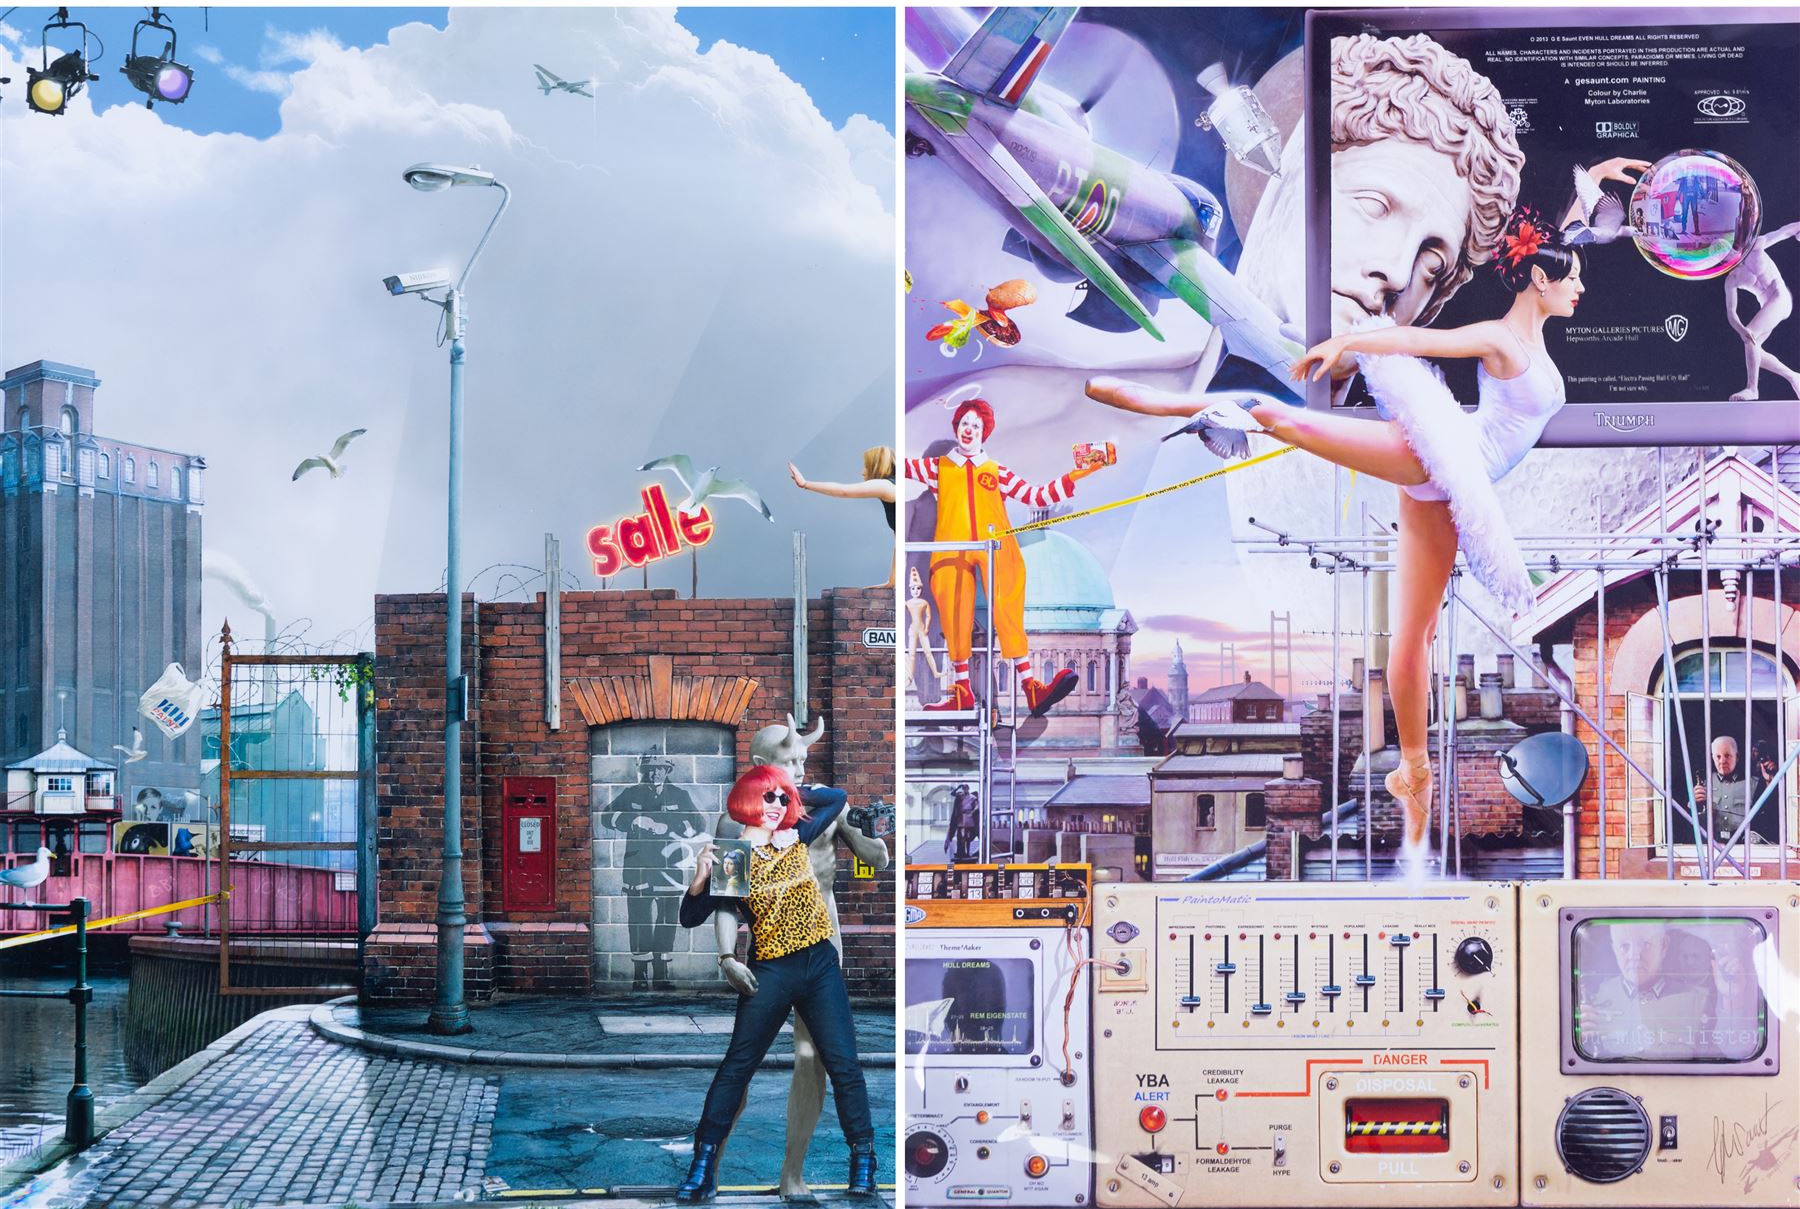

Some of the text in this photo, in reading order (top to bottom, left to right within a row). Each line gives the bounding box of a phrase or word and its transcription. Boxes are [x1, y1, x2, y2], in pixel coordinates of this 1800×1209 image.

[1575, 77, 1629, 86] gesaunt.com
[1613, 89, 1621, 98] by
[1584, 97, 1650, 106] Myton Laboratories
[1613, 122, 1637, 130] BOLDLY
[1566, 335, 1600, 343] Hepworths
[1145, 484, 1178, 498] ARTWORK
[584, 482, 714, 579] sale
[1005, 523, 1040, 535] ARTWORK
[1182, 894, 1252, 904] PaintoMatic
[961, 961, 991, 969] DREAMS
[1373, 1054, 1428, 1065] DANGER
[1135, 1074, 1170, 1088] YBA
[1356, 1078, 1436, 1092] DISPOSAL
[1134, 1091, 1171, 1101] ALERT
[1377, 1161, 1419, 1175] PULL
